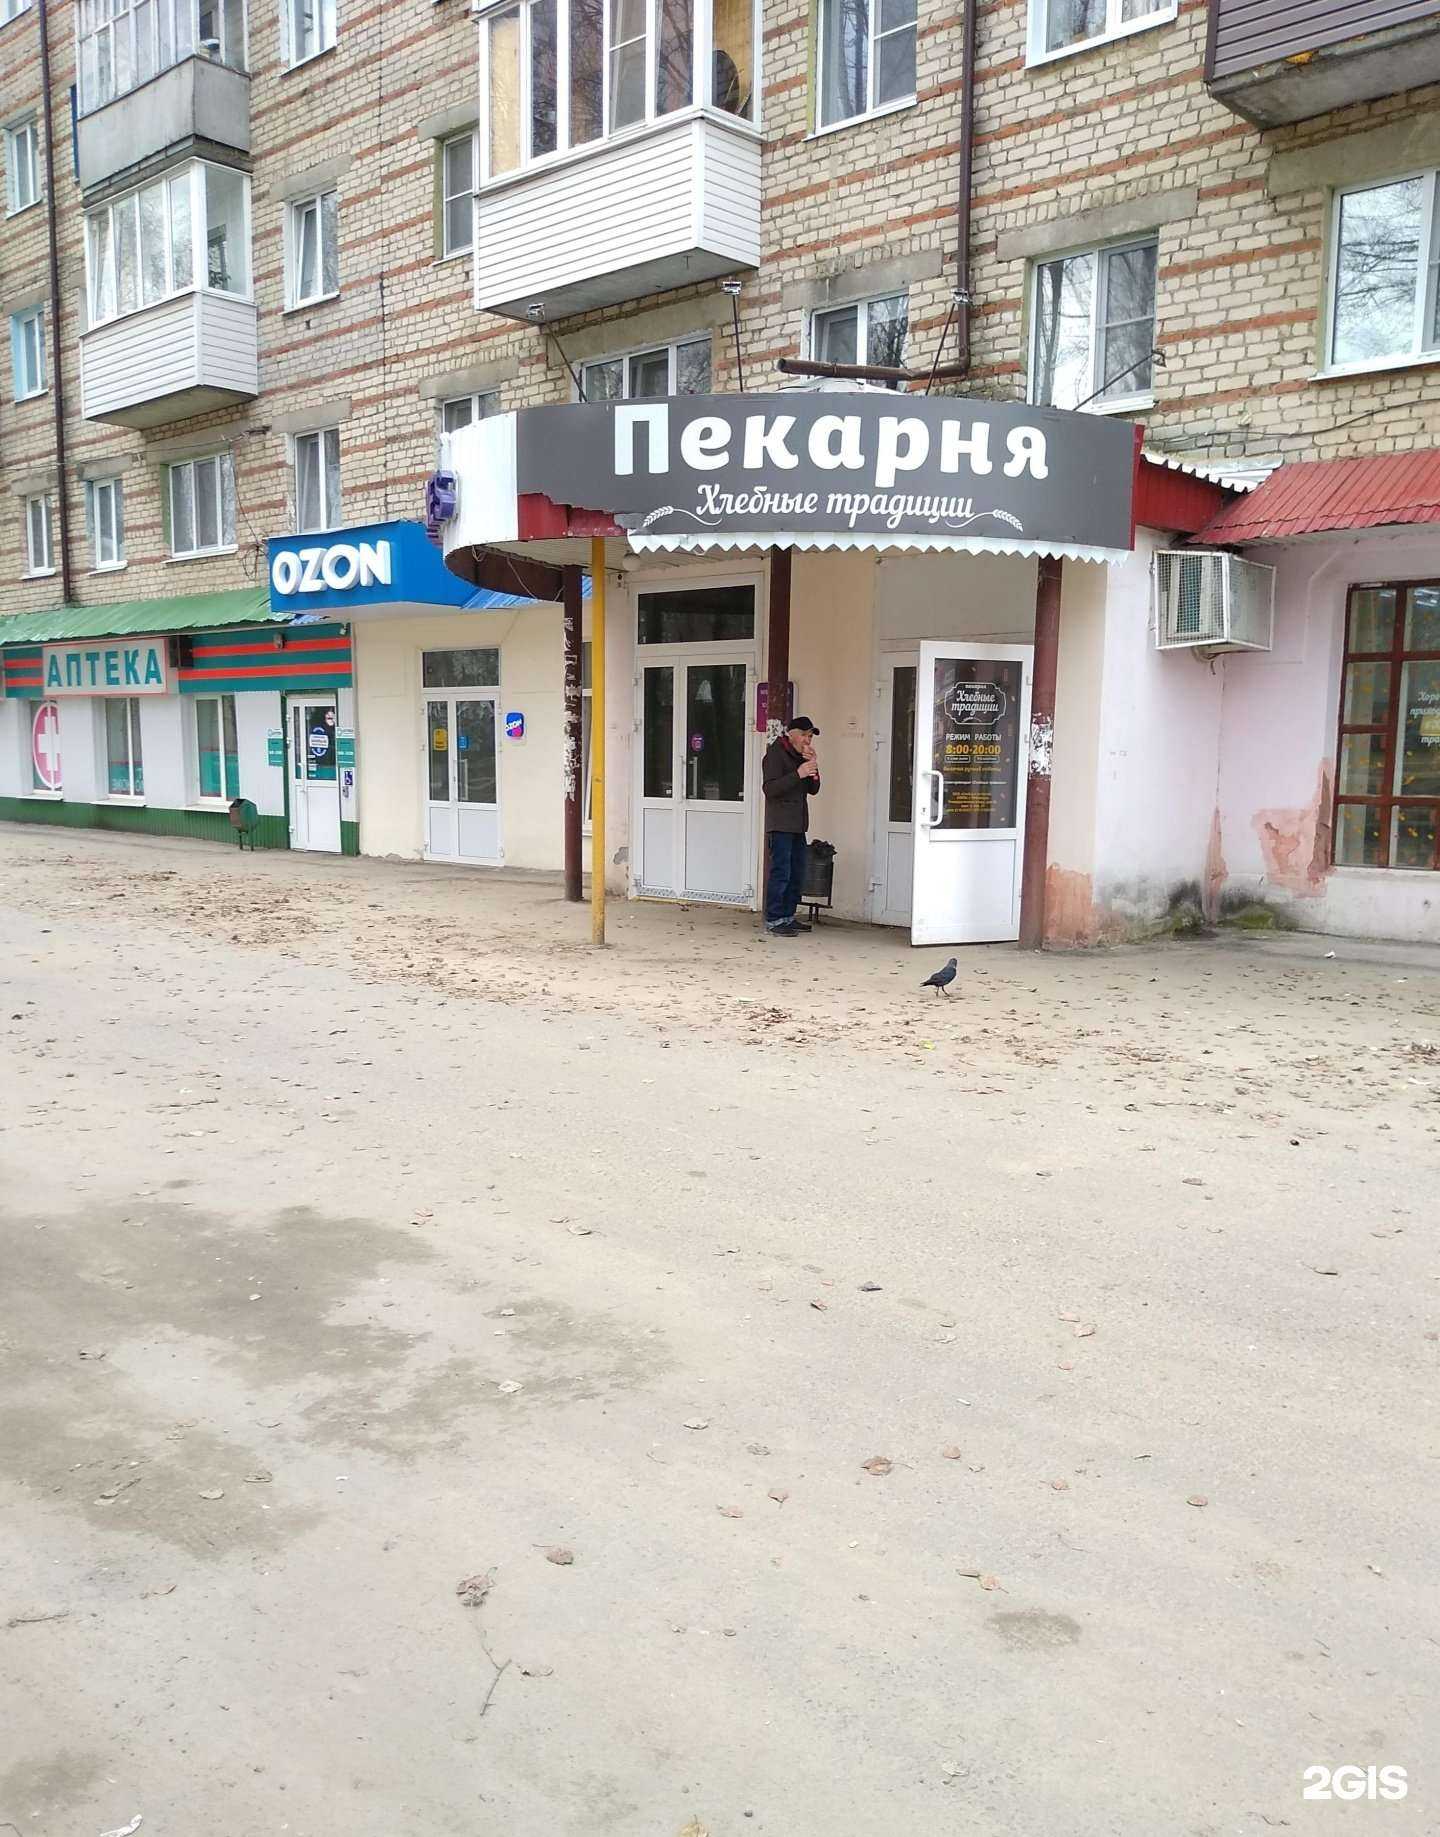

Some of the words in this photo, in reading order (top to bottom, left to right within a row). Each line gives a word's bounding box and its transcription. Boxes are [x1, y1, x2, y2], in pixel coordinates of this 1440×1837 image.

[614, 403, 1049, 488] Пекарня
[696, 484, 818, 516] Хлебные
[826, 489, 975, 530] традиции
[272, 540, 391, 595] OZON
[48, 648, 162, 687] АПТЕКА
[951, 703, 999, 716] традиции
[956, 689, 996, 702] Хлебные
[945, 733, 971, 741] РЕЖИМ
[974, 733, 1002, 741] РАБОТЫ
